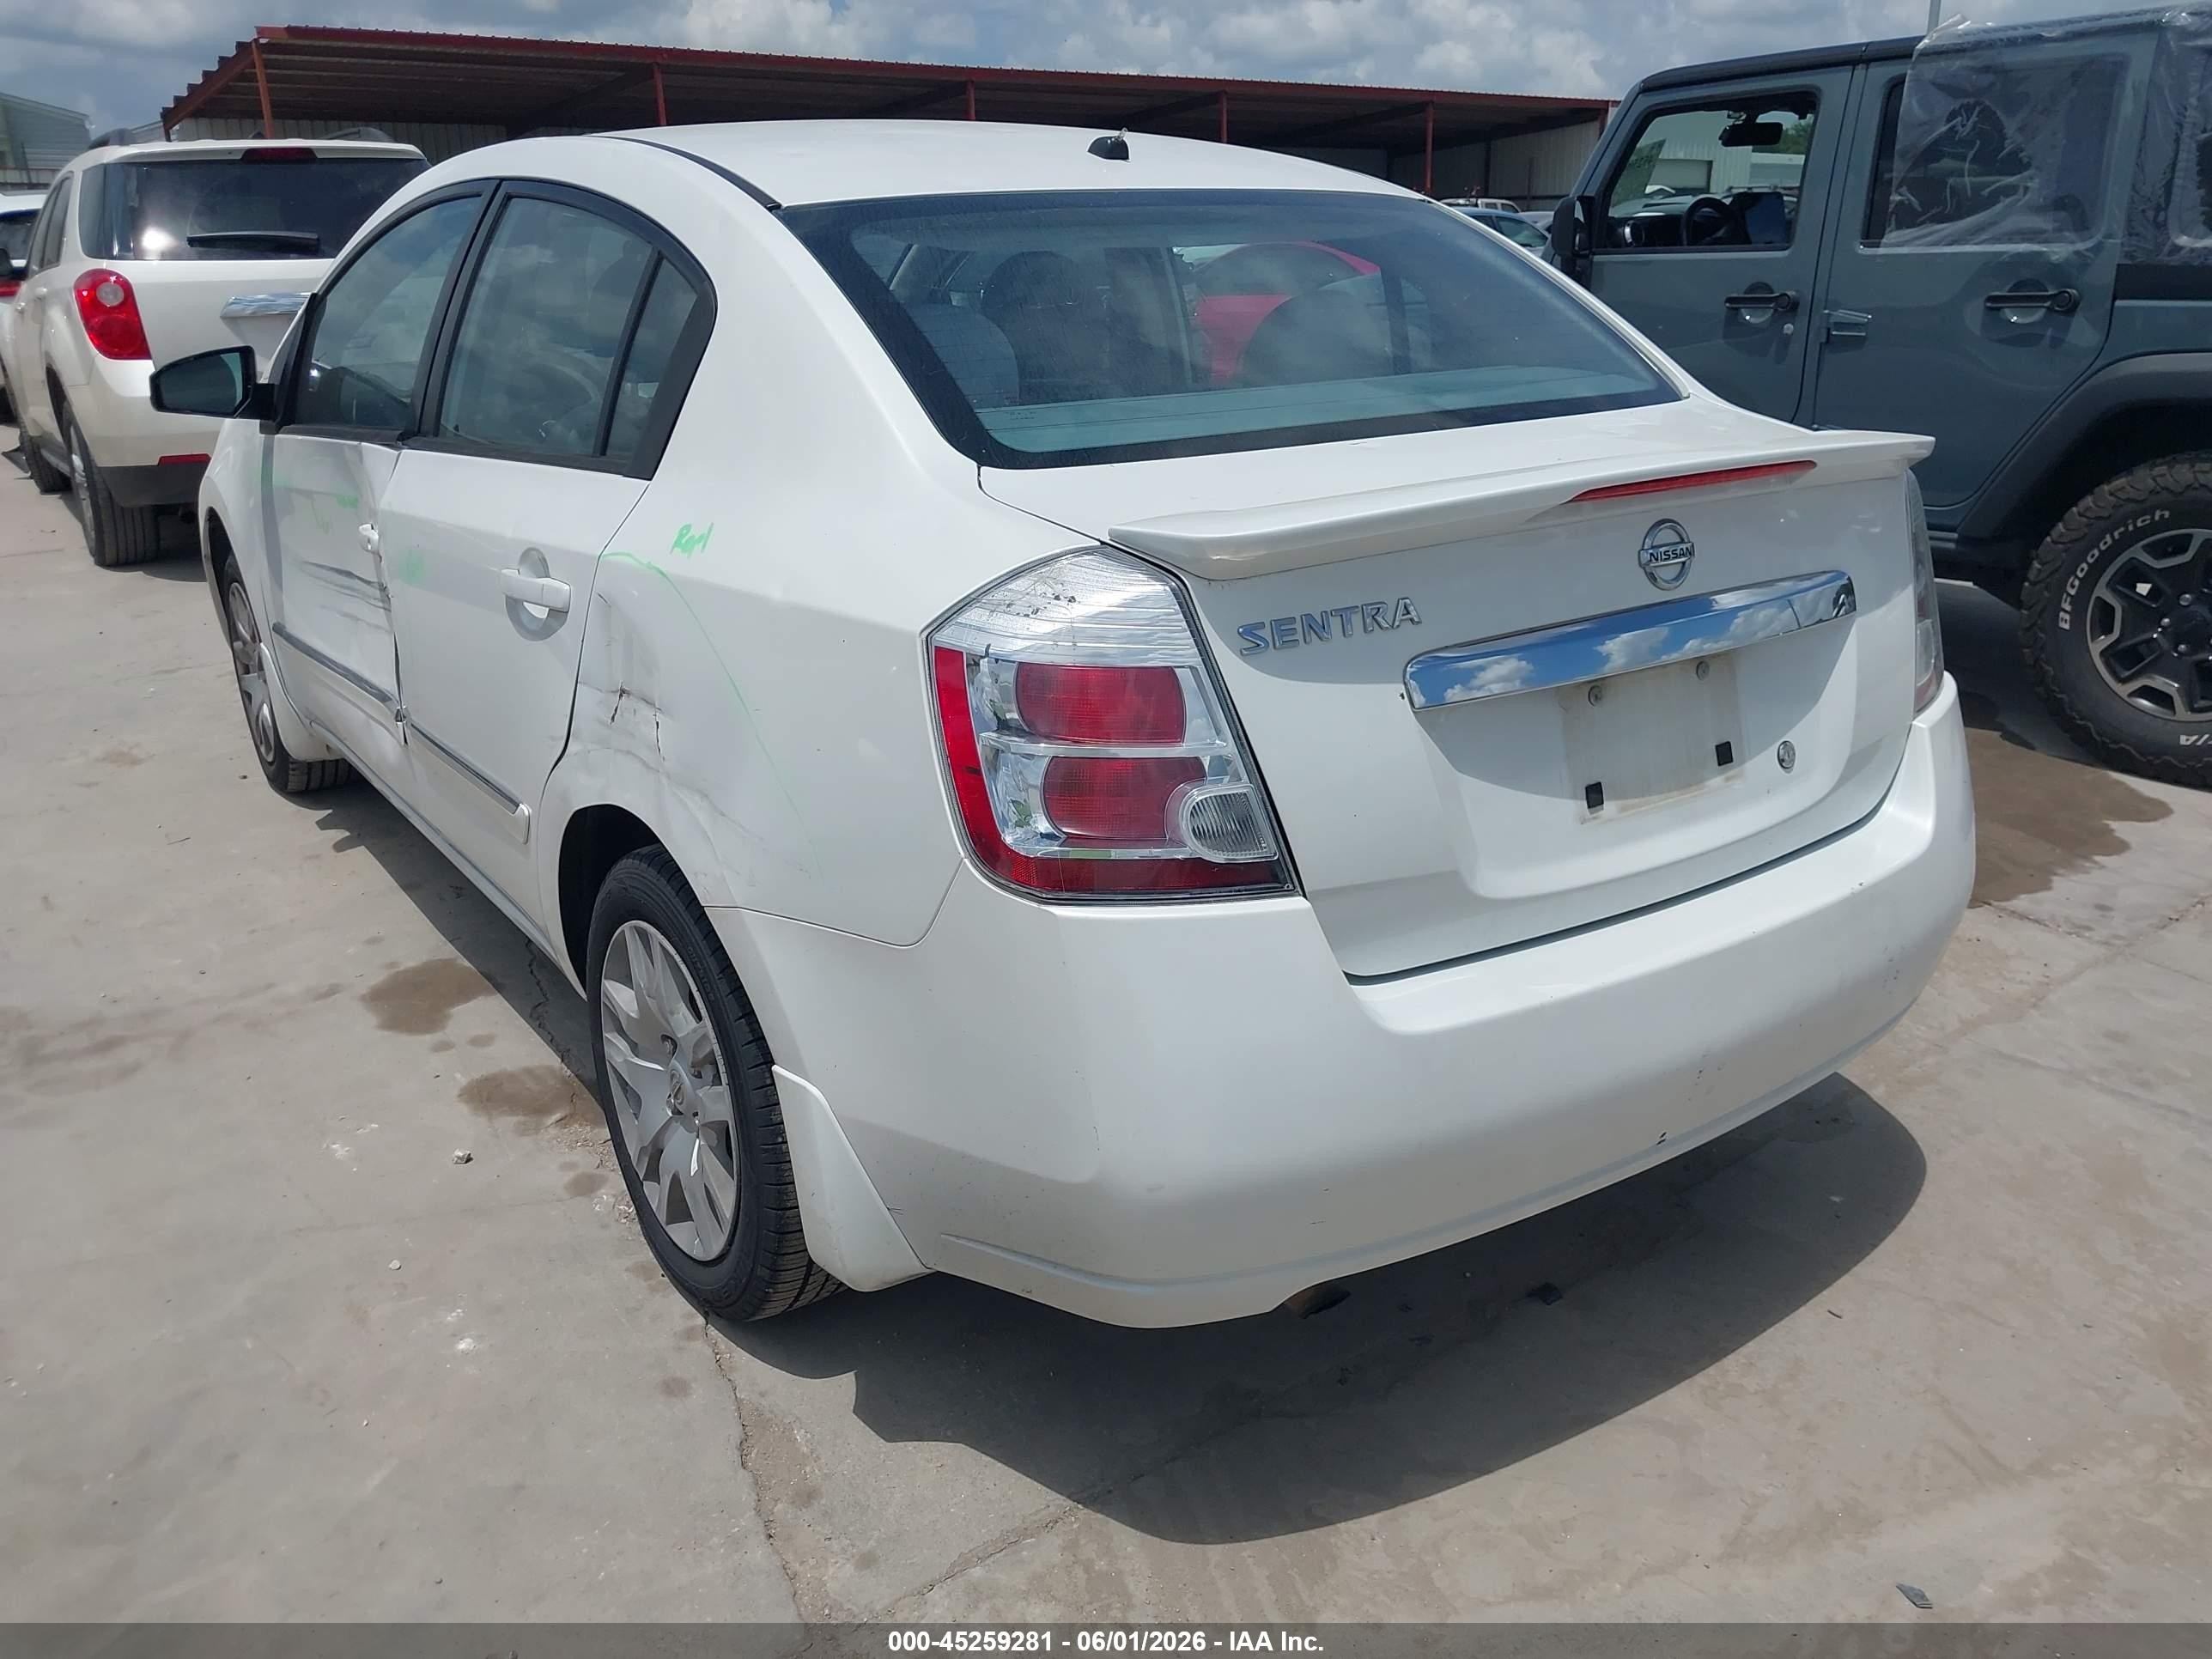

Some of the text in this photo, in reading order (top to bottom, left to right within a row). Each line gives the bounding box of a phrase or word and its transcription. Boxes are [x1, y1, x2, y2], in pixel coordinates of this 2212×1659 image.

[1649, 547, 1692, 562] NISSAN
[2057, 508, 2171, 631] BFGoodrich
[1237, 597, 1423, 656] SENTRA
[2179, 733, 2212, 745] /A
